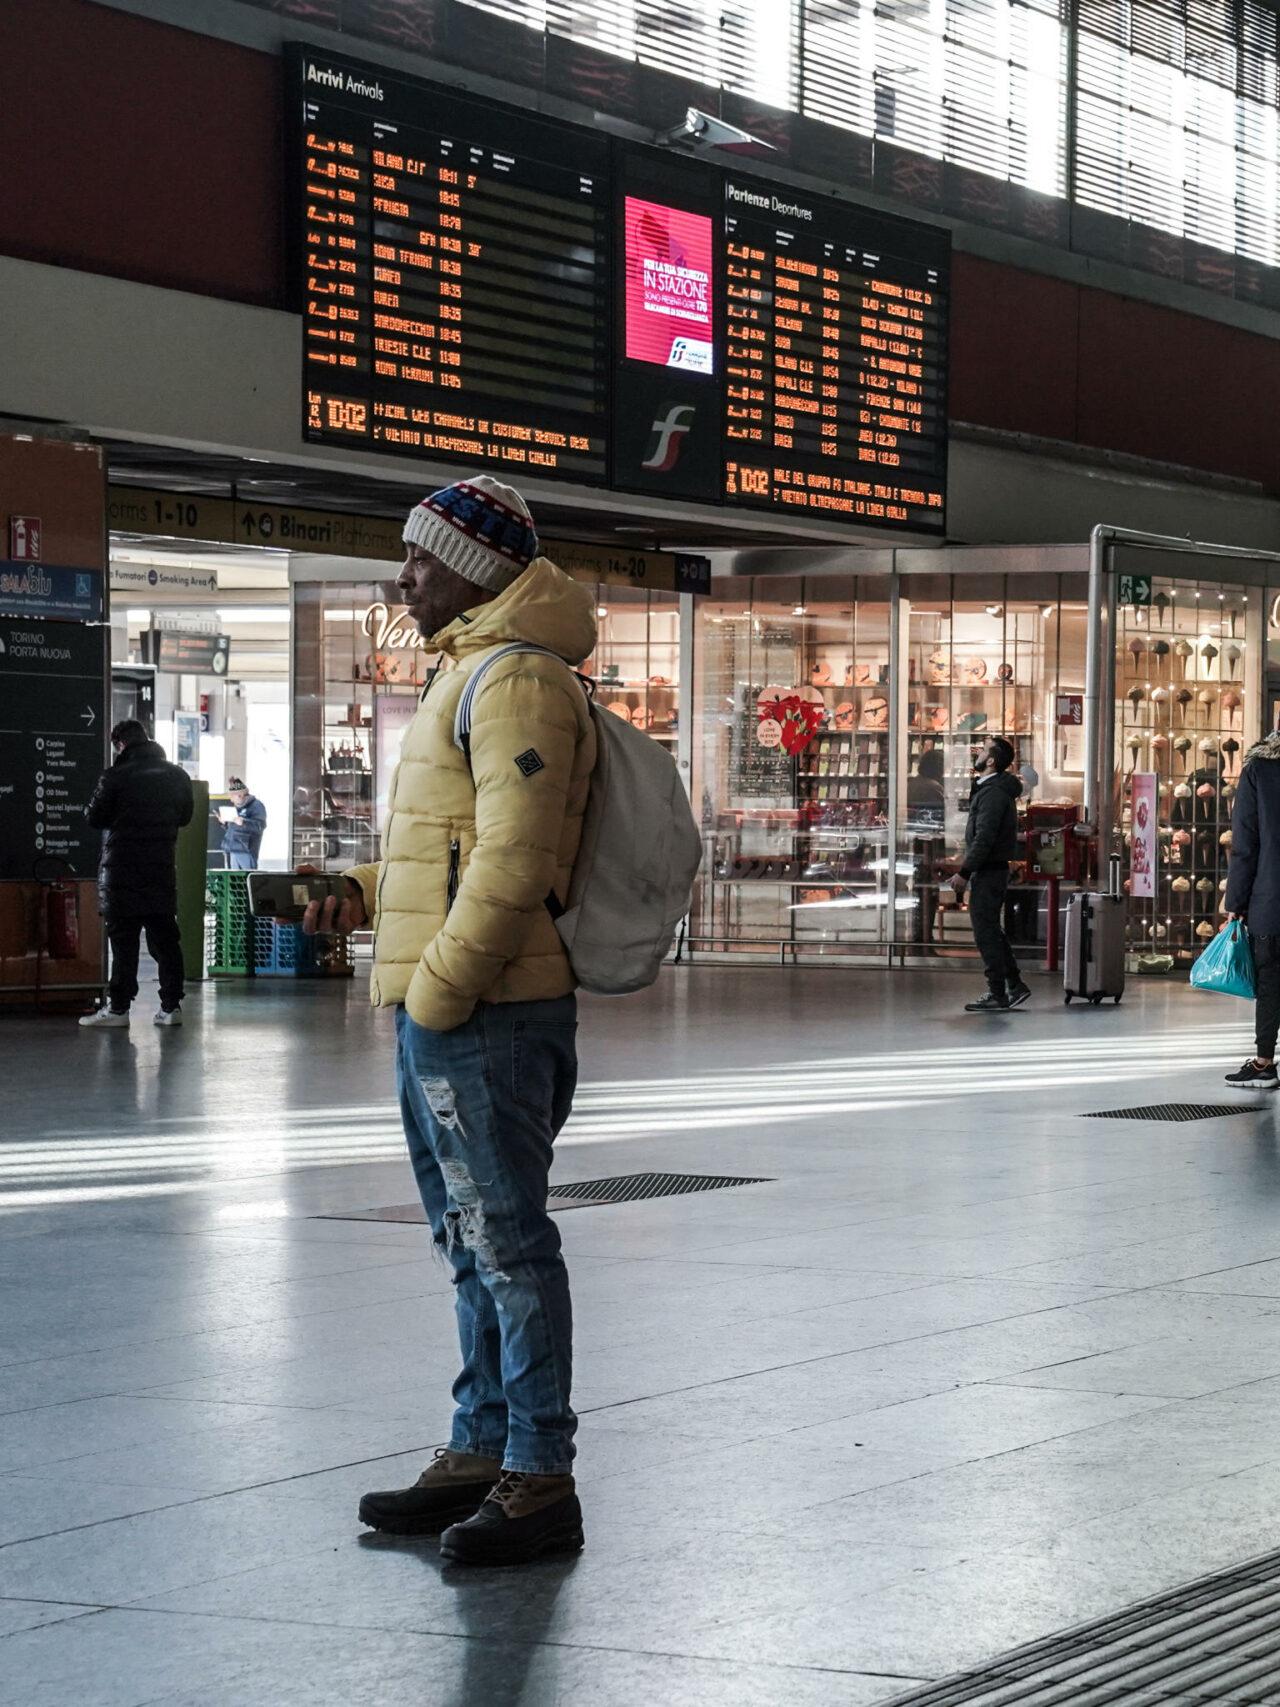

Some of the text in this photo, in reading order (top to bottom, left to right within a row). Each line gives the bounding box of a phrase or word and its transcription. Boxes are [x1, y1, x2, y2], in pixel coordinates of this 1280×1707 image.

[307, 64, 384, 101] Arrivi Arrivals
[728, 185, 812, 220] Partenze Departures
[644, 270, 707, 300] IN STAZIONE
[374, 337, 408, 356] TRIESTE
[280, 515, 396, 549] Binari Platforms
[115, 570, 207, 586] Fumatori Smoking Area
[11, 632, 44, 644] TORINO
[10, 646, 71, 659] PORTA NUOVA
[141, 686, 151, 701] 14
